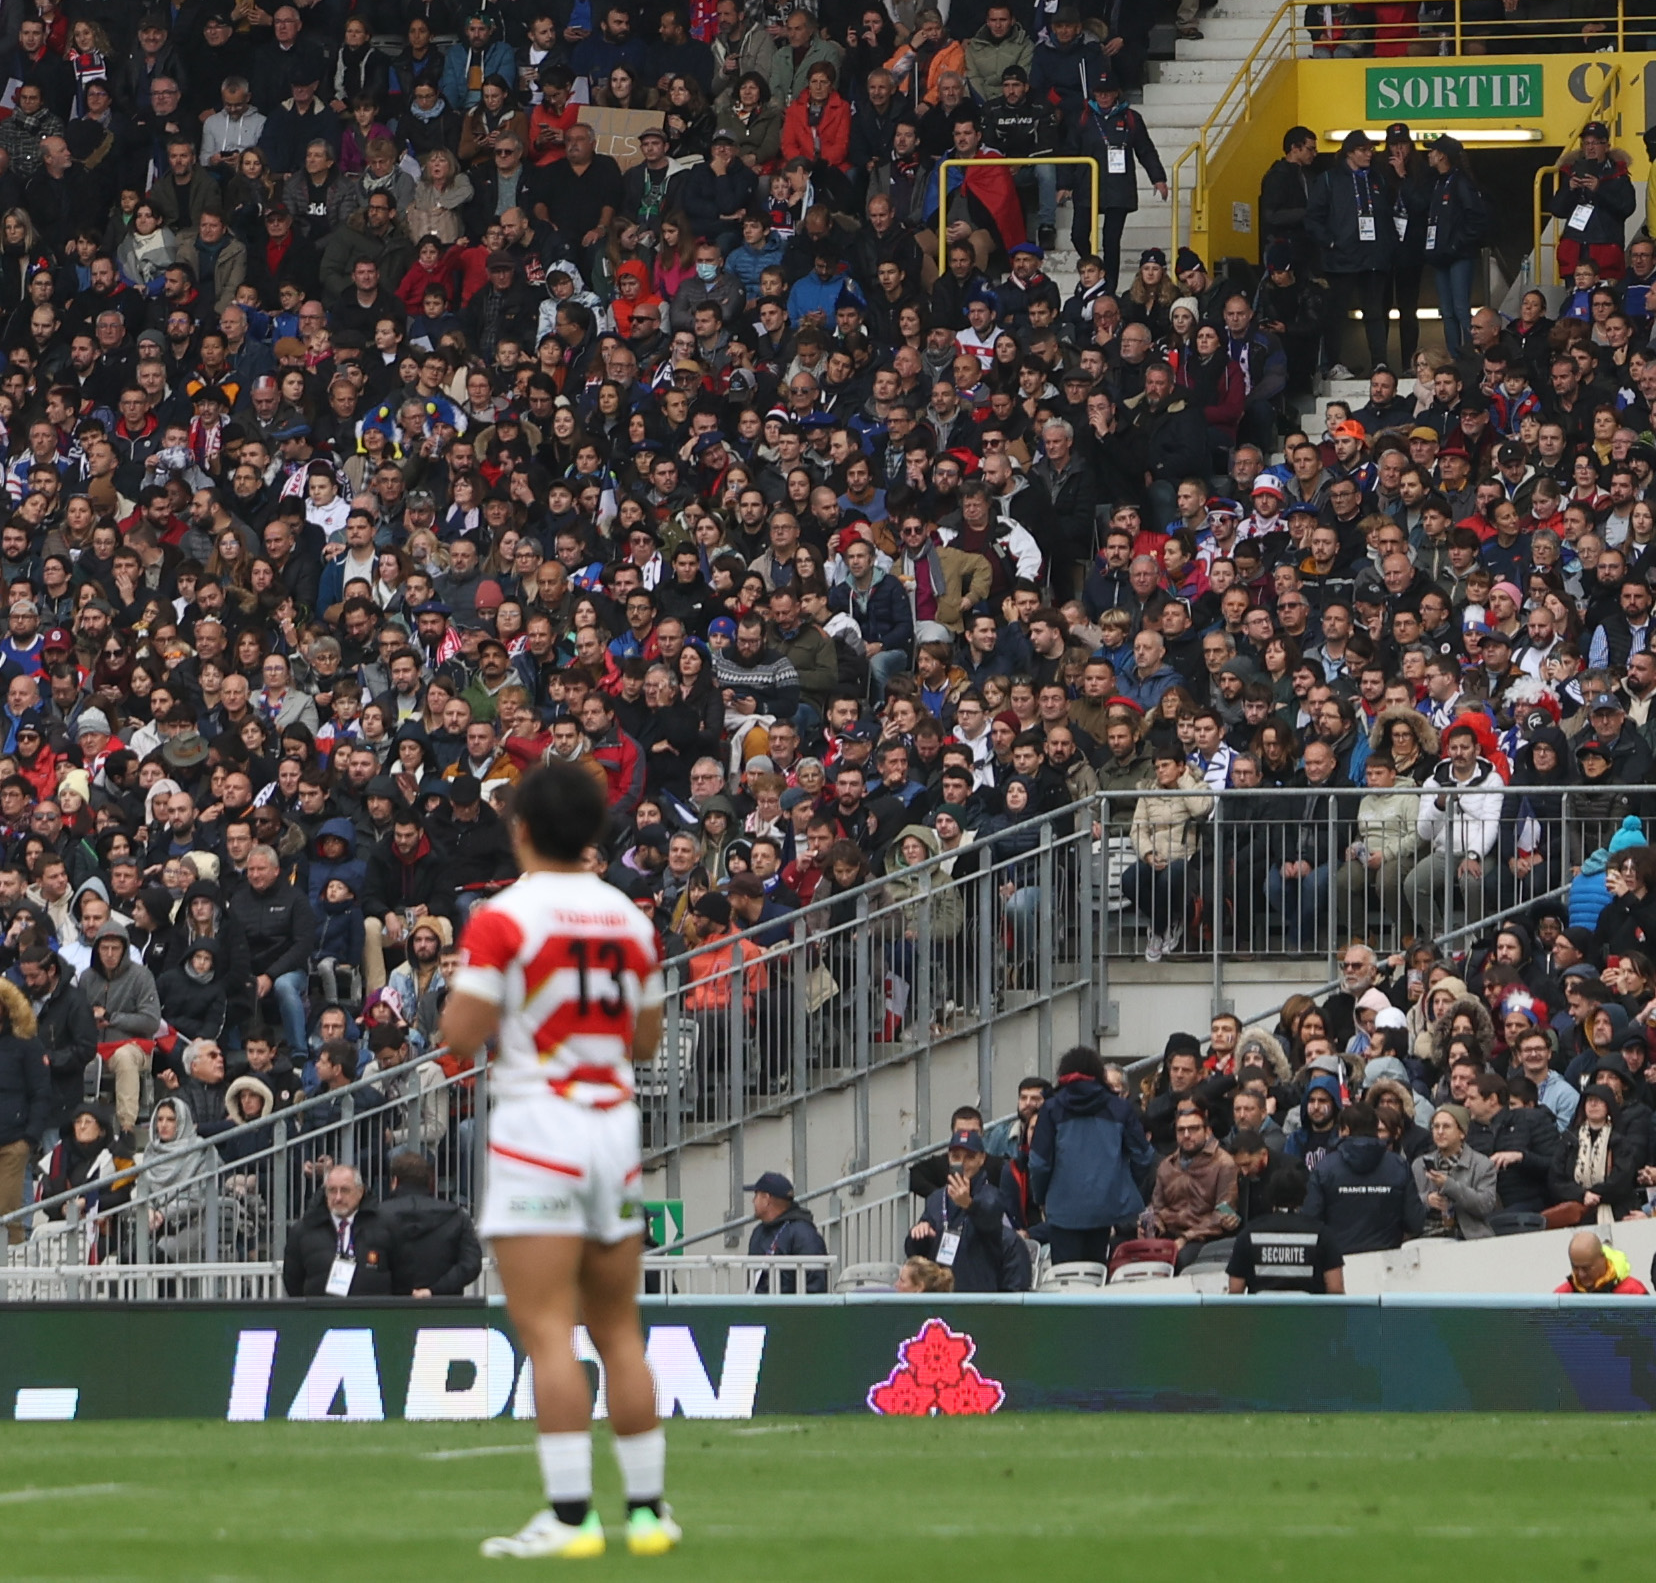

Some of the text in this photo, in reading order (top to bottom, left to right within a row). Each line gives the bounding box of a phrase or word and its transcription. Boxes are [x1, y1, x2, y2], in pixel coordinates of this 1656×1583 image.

[1378, 74, 1531, 109] SORTIE
[569, 938, 628, 1020] 13
[1261, 1246, 1305, 1264] SECURITE
